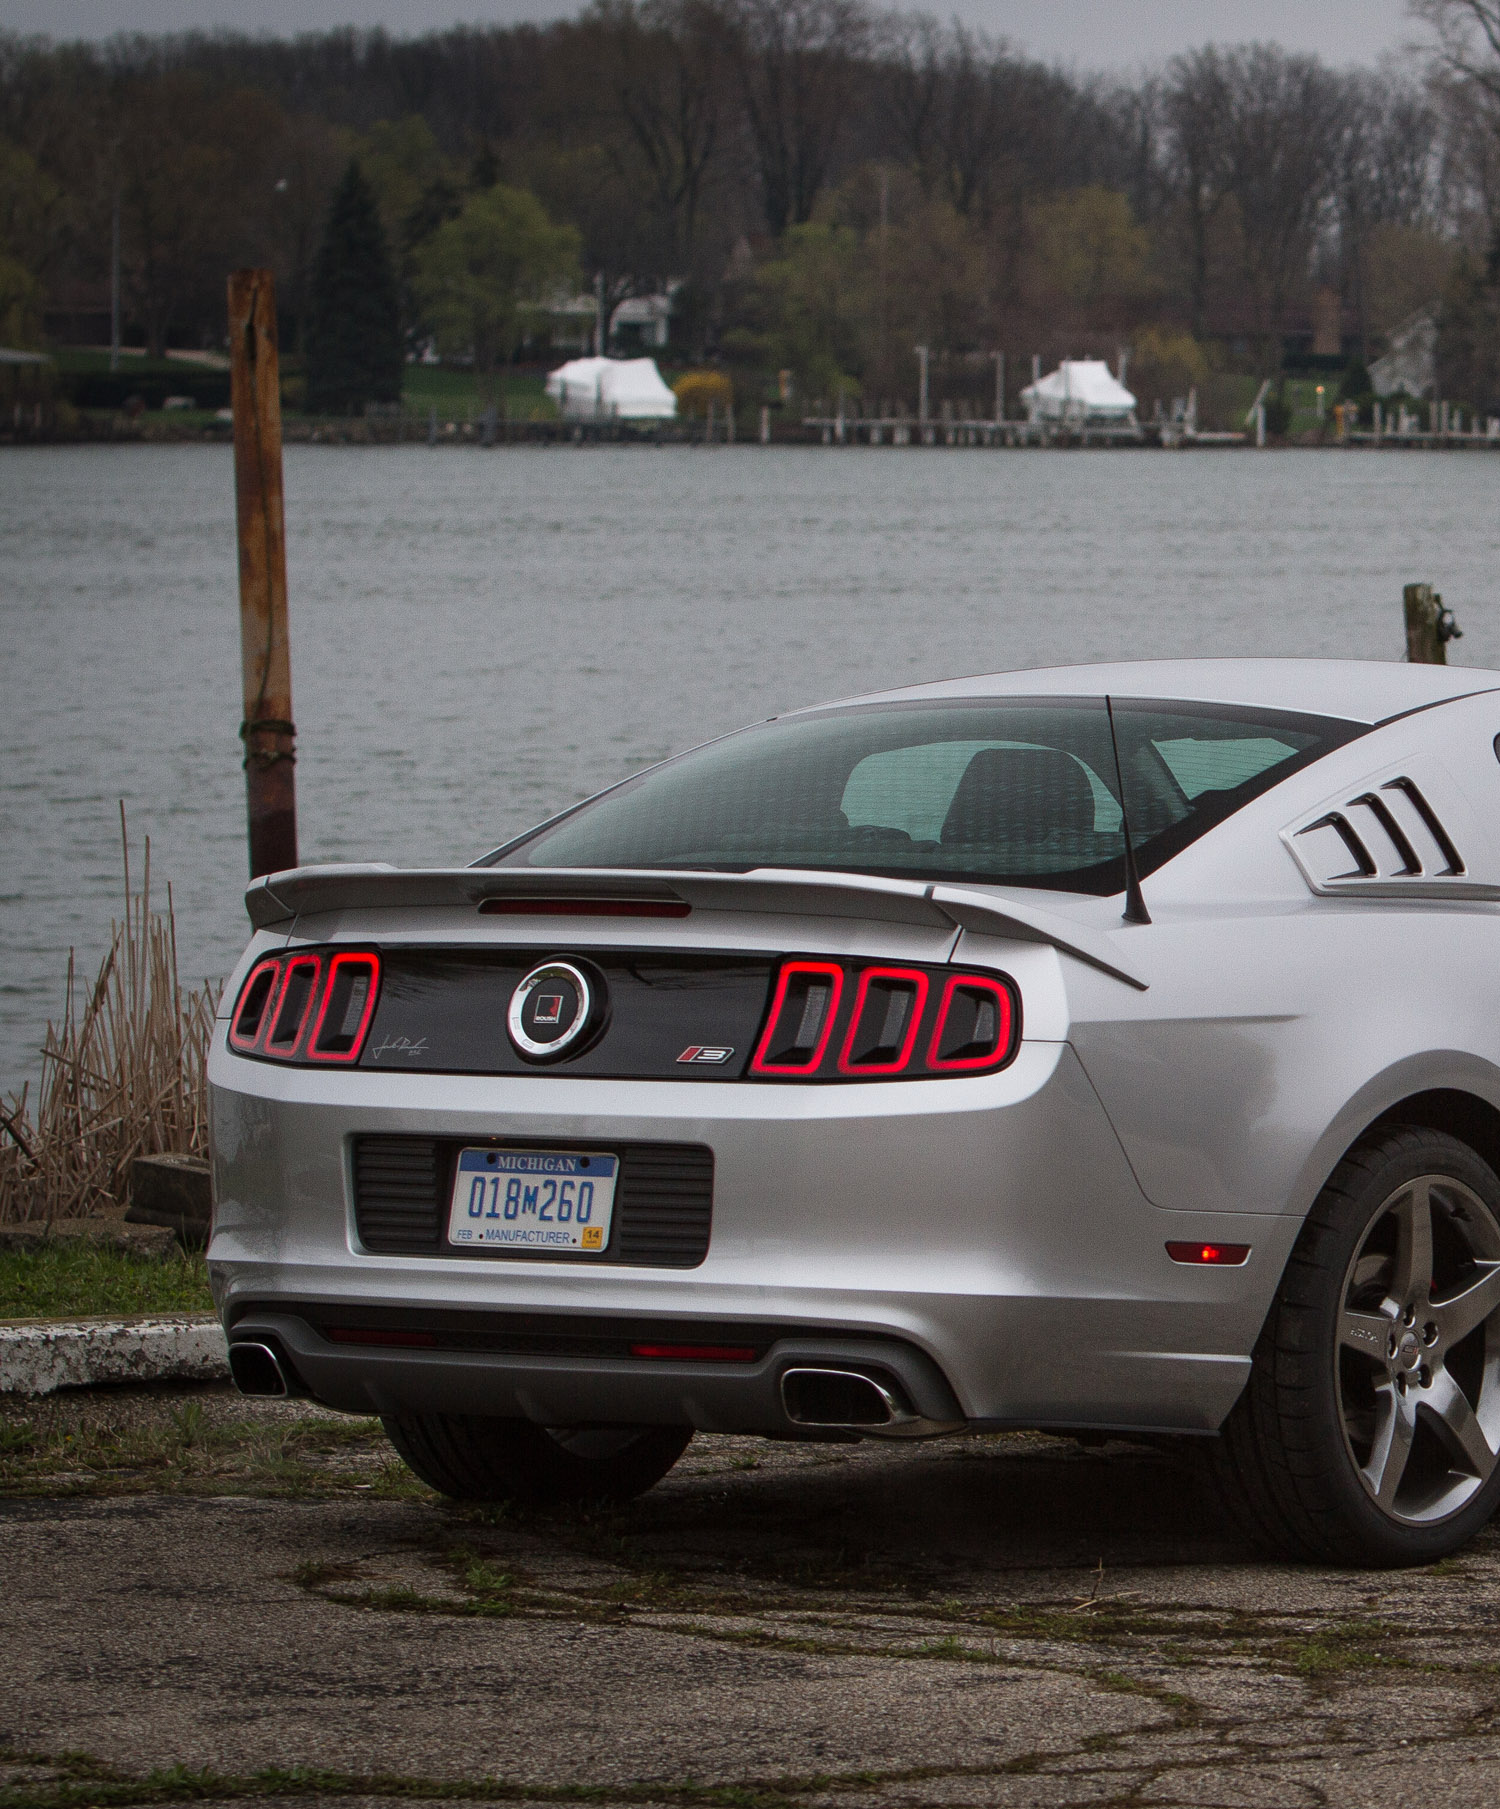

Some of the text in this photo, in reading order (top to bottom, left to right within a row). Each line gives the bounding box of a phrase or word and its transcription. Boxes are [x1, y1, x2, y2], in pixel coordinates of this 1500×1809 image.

[497, 1155, 577, 1172] MICHIGAN
[468, 1175, 595, 1224] 018M260
[456, 1229, 474, 1240] FEB
[485, 1229, 570, 1245] MANUFACTURER
[586, 1230, 600, 1239] 14
